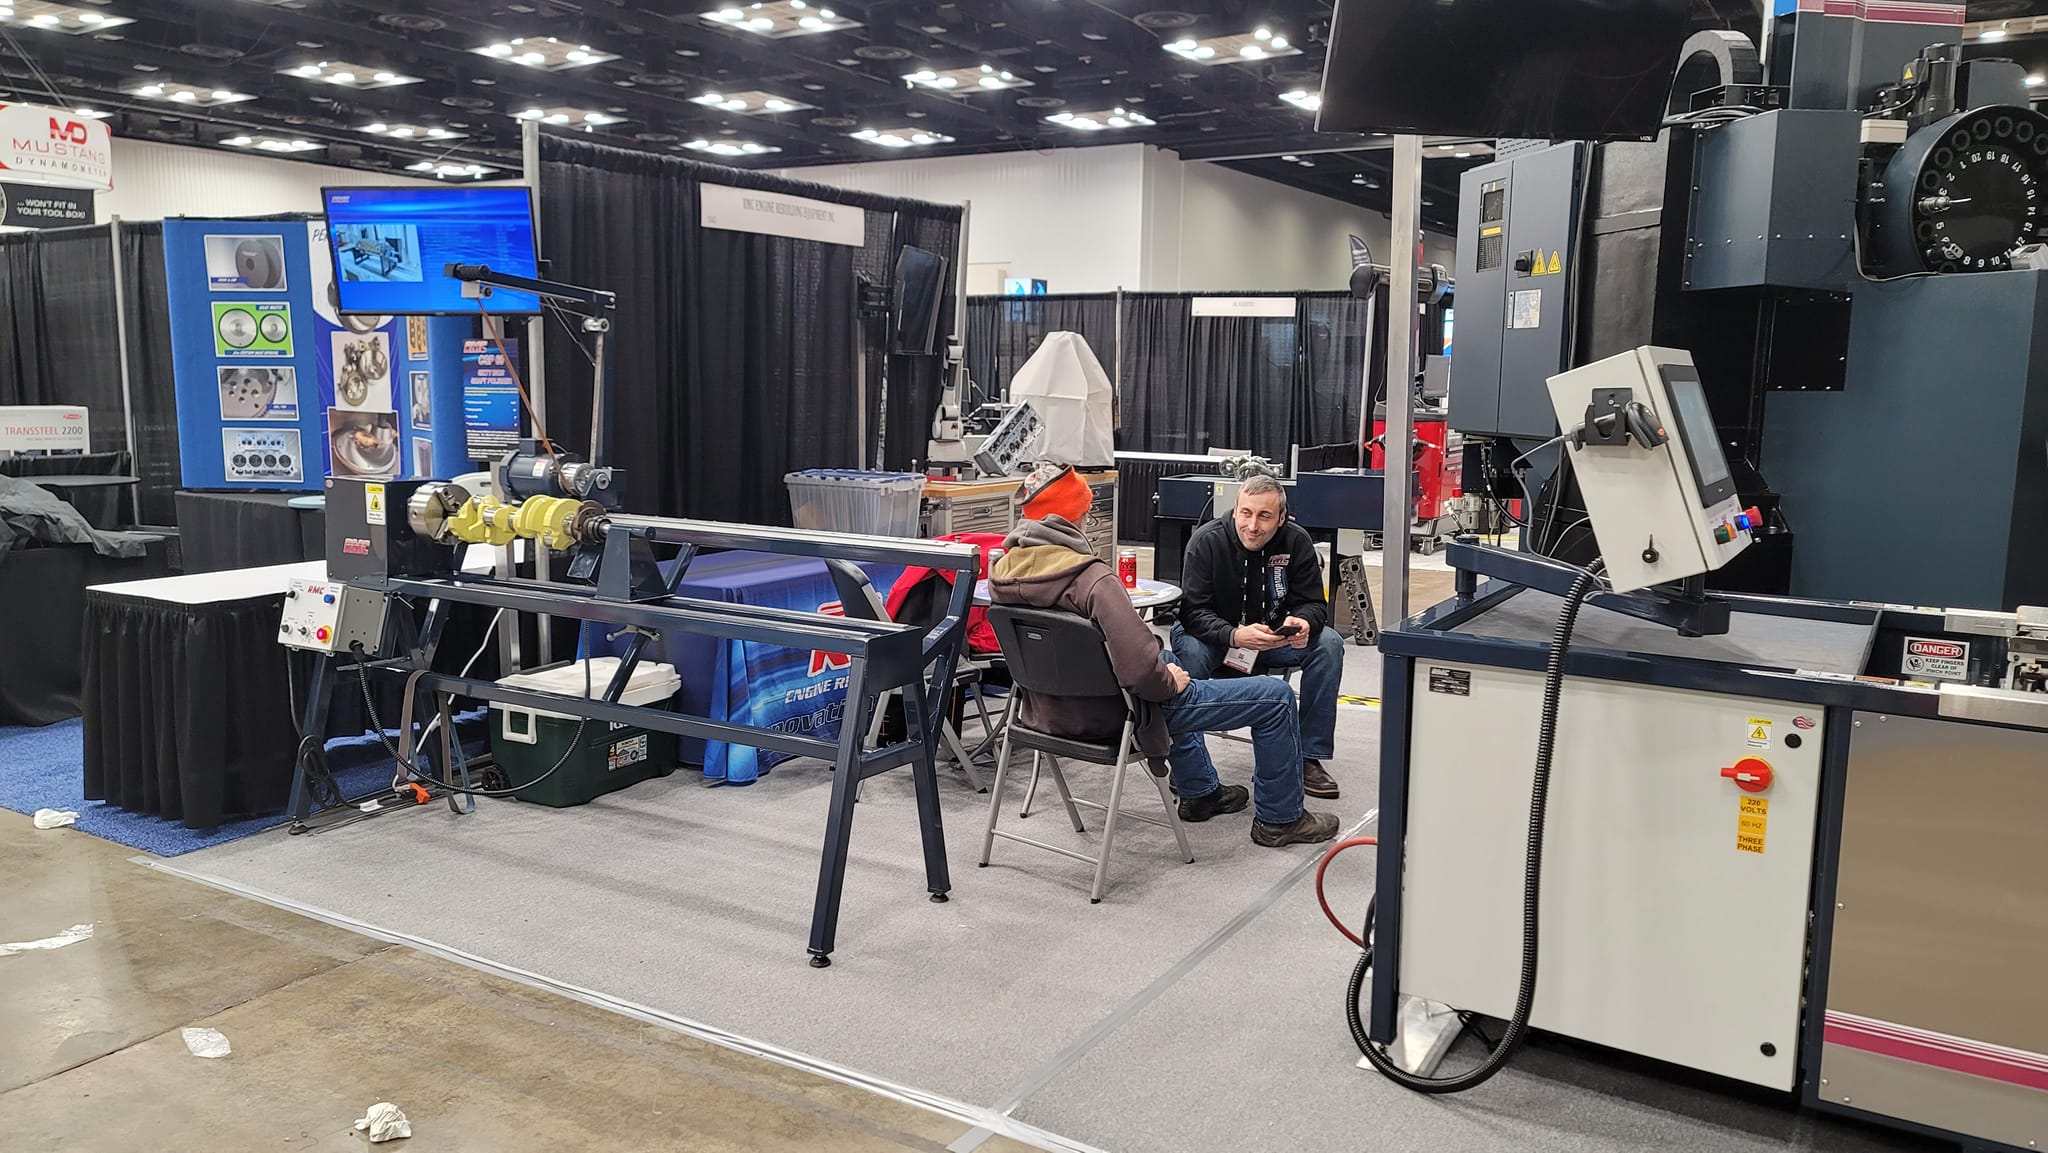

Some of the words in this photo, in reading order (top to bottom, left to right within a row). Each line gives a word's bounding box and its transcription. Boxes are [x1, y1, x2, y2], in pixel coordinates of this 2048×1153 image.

[49, 116, 87, 145] MD
[13, 138, 105, 165] MUSTANG
[1986, 150, 1995, 160] 19
[1971, 152, 1982, 163] 20
[2000, 153, 2010, 164] 18
[1960, 161, 1967, 169] 1
[2011, 161, 2022, 172] 17
[1946, 172, 1956, 182] 2
[2021, 174, 2031, 185] 16
[1938, 187, 1948, 196] 3
[53, 201, 67, 209] FIT
[67, 201, 77, 209] IN
[17, 206, 42, 216] YOUR
[42, 209, 65, 217] TOOL
[2027, 206, 2036, 216] 14
[2023, 221, 2033, 232] 13
[1963, 255, 1971, 265] 8
[1978, 258, 1985, 268] 9
[1990, 256, 2000, 266] 10
[5, 427, 58, 436] TRANSSTEEL
[62, 426, 83, 435] 2200
[307, 585, 325, 595] RMC
[1914, 643, 1959, 656] DANGER
[785, 679, 832, 704] ENGINE
[1747, 798, 1761, 807] 220
[1740, 806, 1767, 815] VOLTS
[1738, 835, 1763, 846] THREE
[1737, 843, 1763, 854] PHASE
